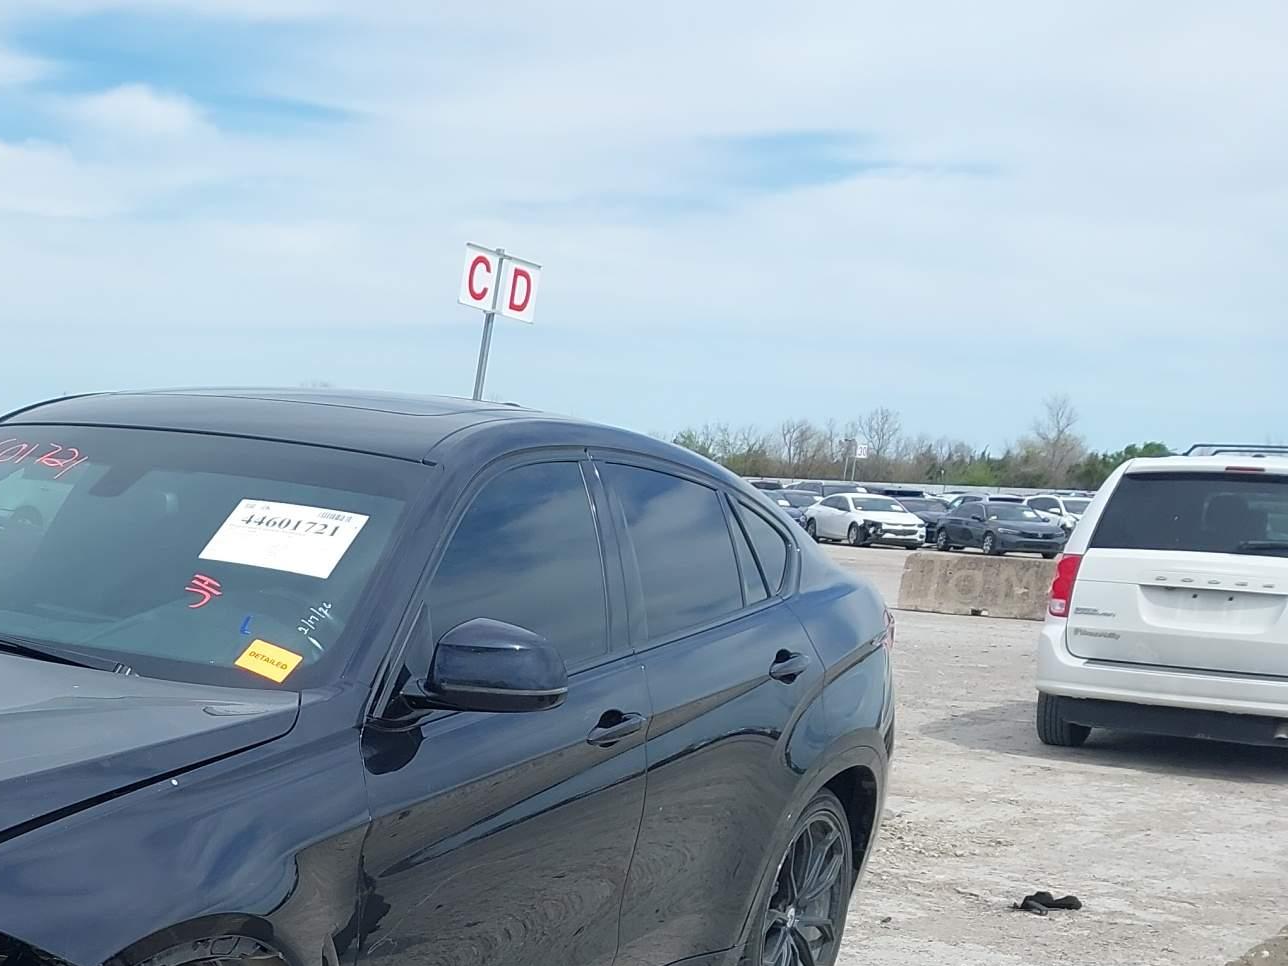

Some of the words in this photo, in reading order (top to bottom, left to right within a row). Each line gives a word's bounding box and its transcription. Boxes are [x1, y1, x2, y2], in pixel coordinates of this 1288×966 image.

[468, 255, 492, 301] C
[508, 267, 532, 312] D
[241, 513, 340, 537] 44601721
[248, 650, 289, 671] DETAILED
